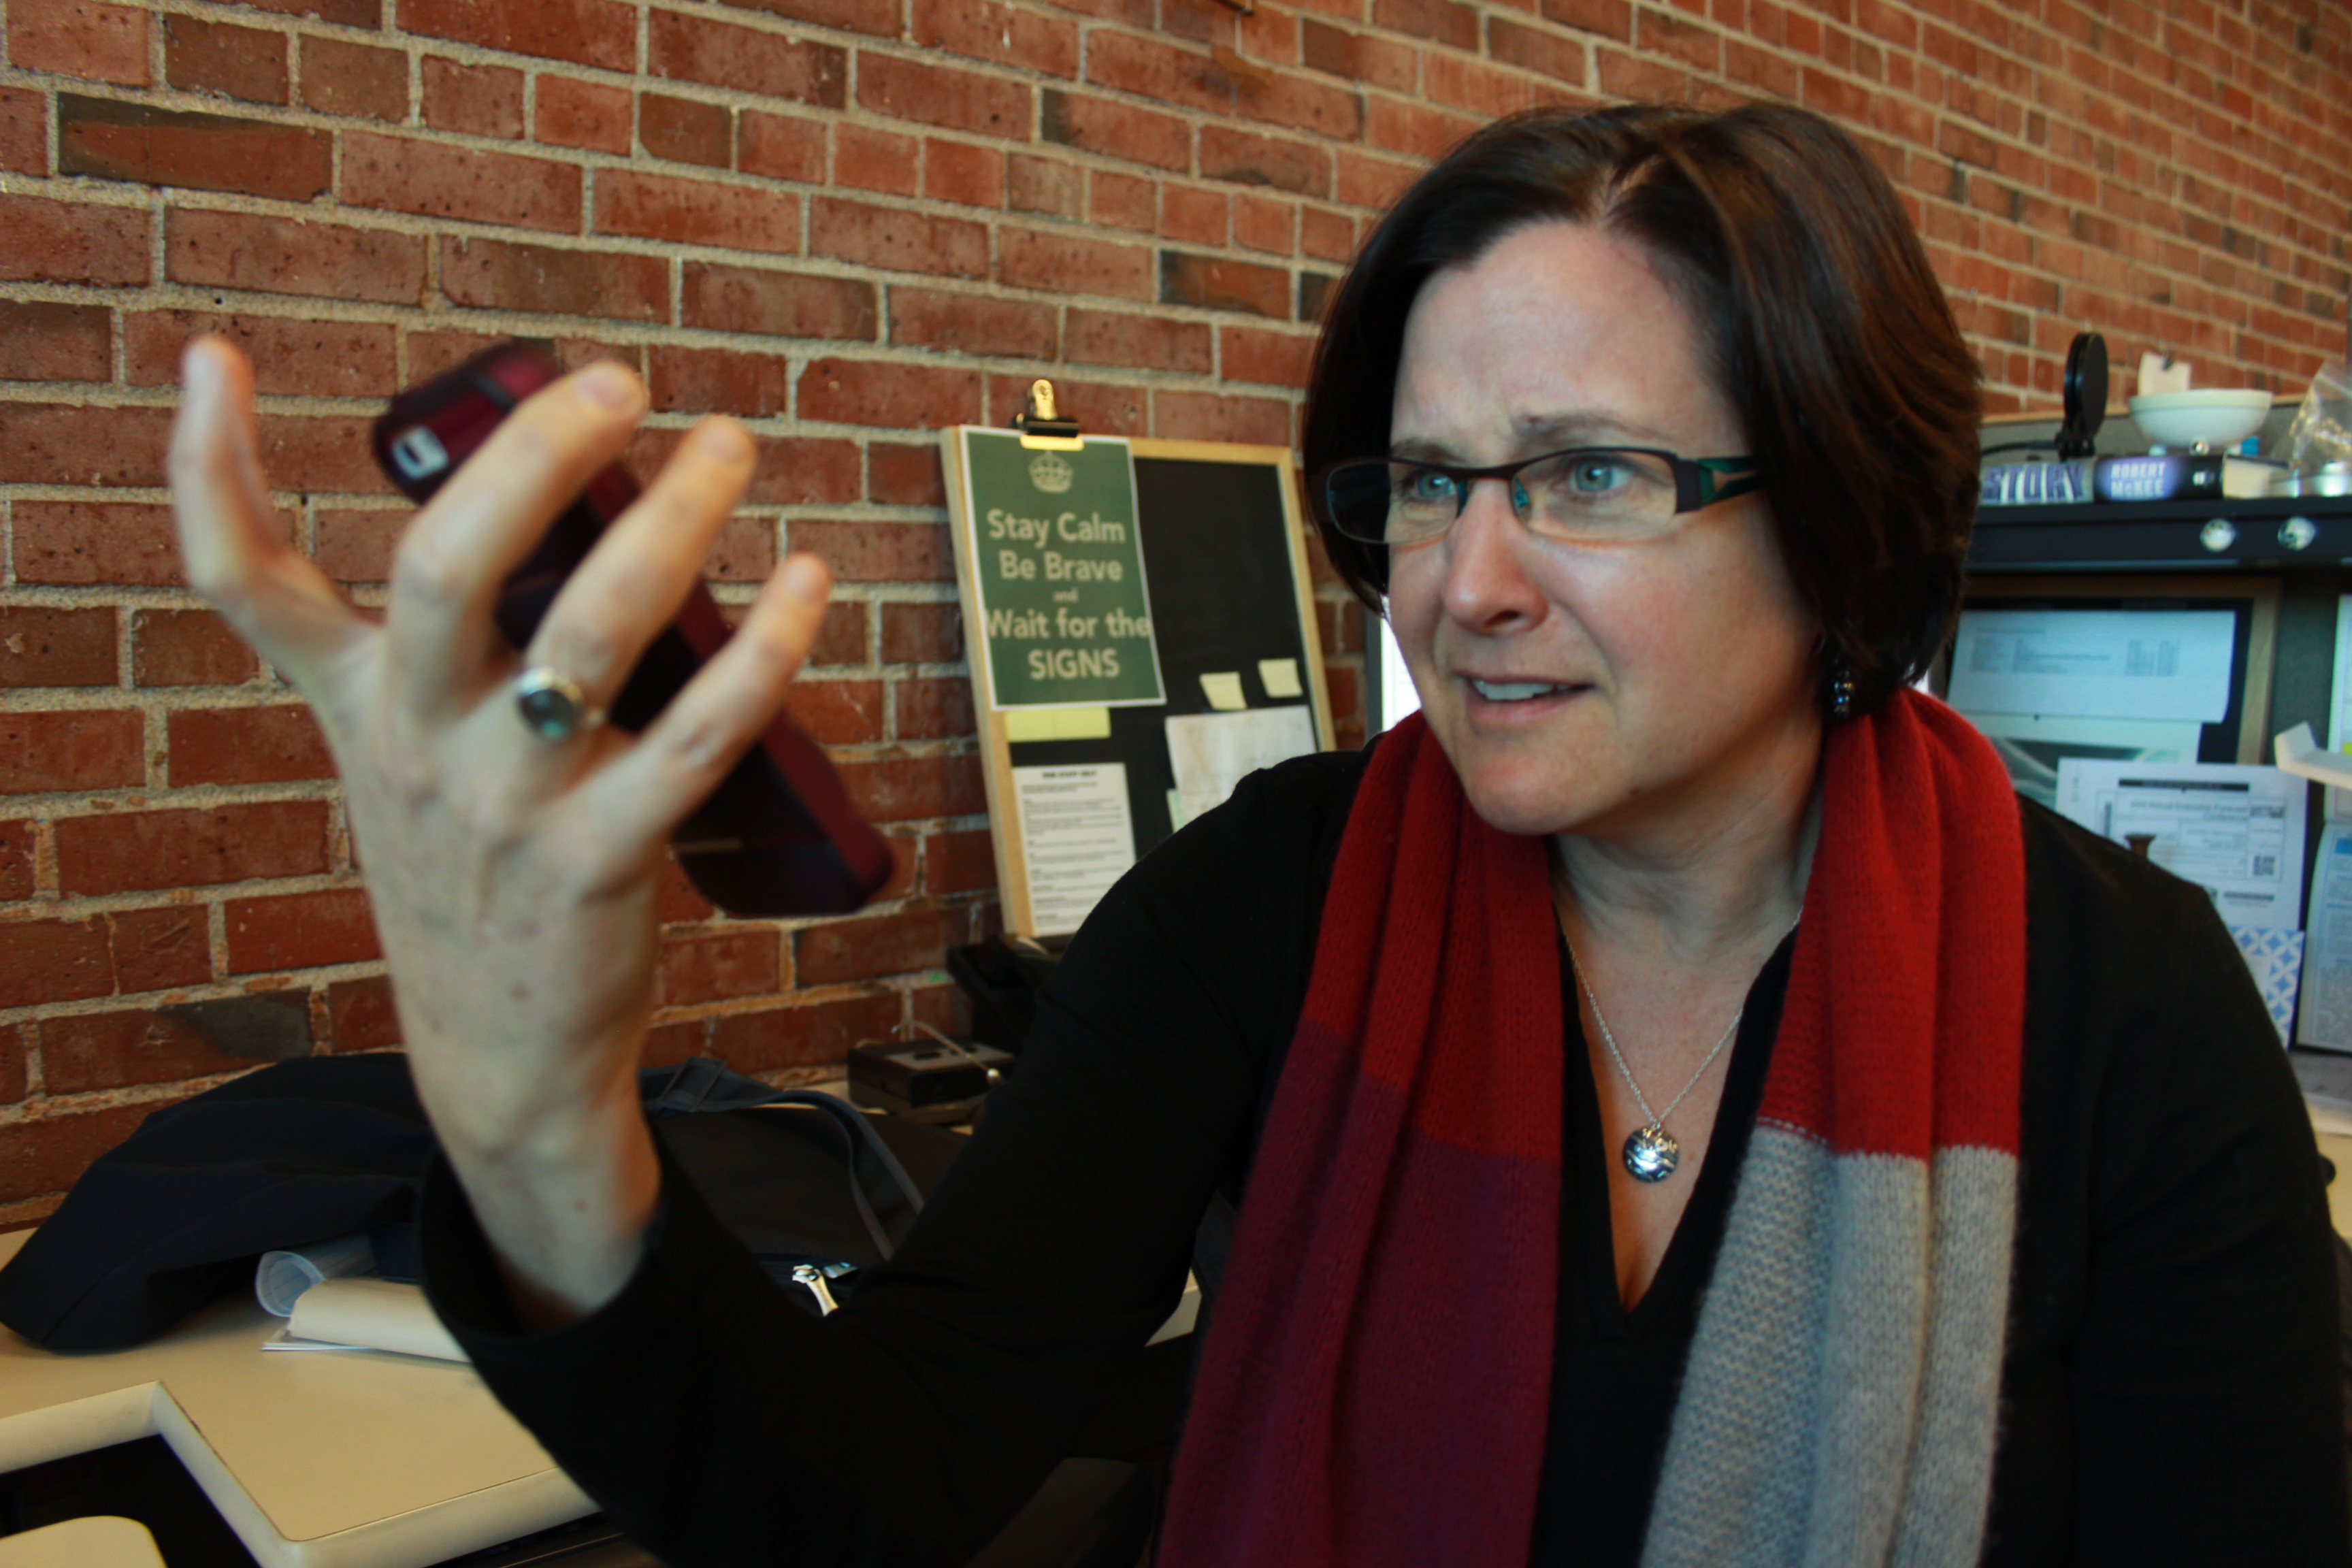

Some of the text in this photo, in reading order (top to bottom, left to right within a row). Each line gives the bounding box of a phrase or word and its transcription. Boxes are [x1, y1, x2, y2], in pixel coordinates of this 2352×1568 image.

[1983, 461, 2087, 502] STORY
[2111, 461, 2166, 478] ROBERT
[987, 508, 1126, 549] Stay Calm
[999, 550, 1123, 582] Be Brave
[1053, 587, 1079, 603] and
[987, 606, 1149, 639] Wait for the
[1028, 647, 1121, 680] SIGNS
